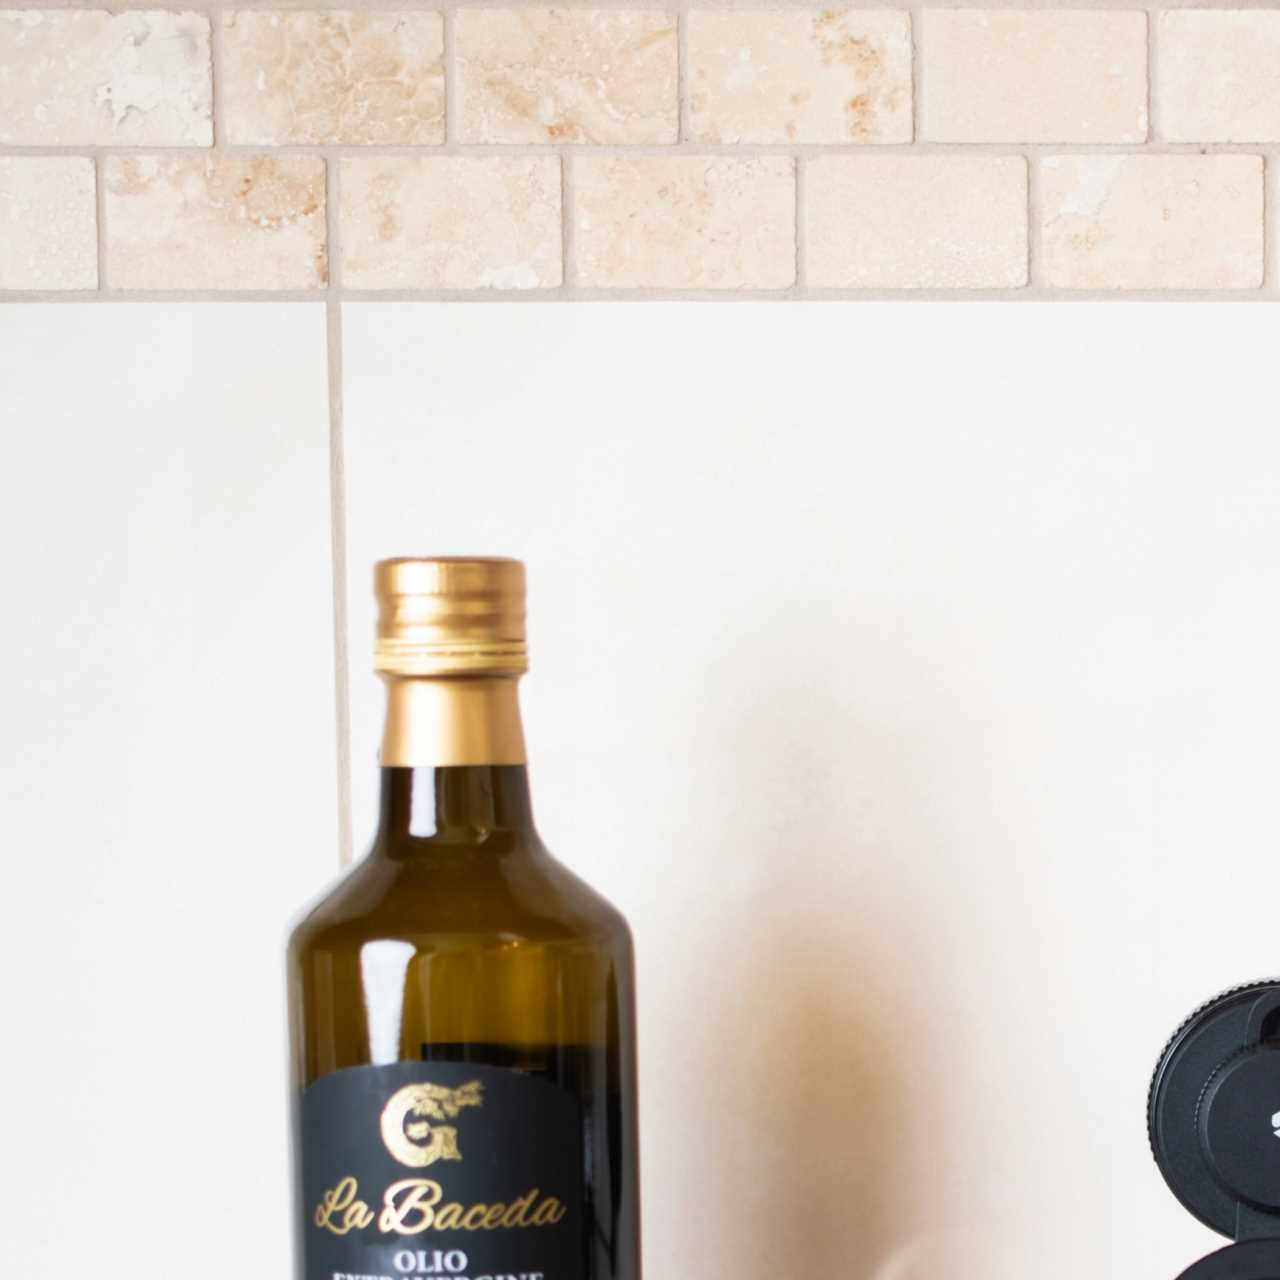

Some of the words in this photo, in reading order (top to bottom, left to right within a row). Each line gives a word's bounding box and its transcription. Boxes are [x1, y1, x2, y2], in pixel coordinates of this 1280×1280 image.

[314, 1176, 375, 1235] La
[379, 1178, 567, 1235] Baceda
[393, 1250, 468, 1273] OLIO
